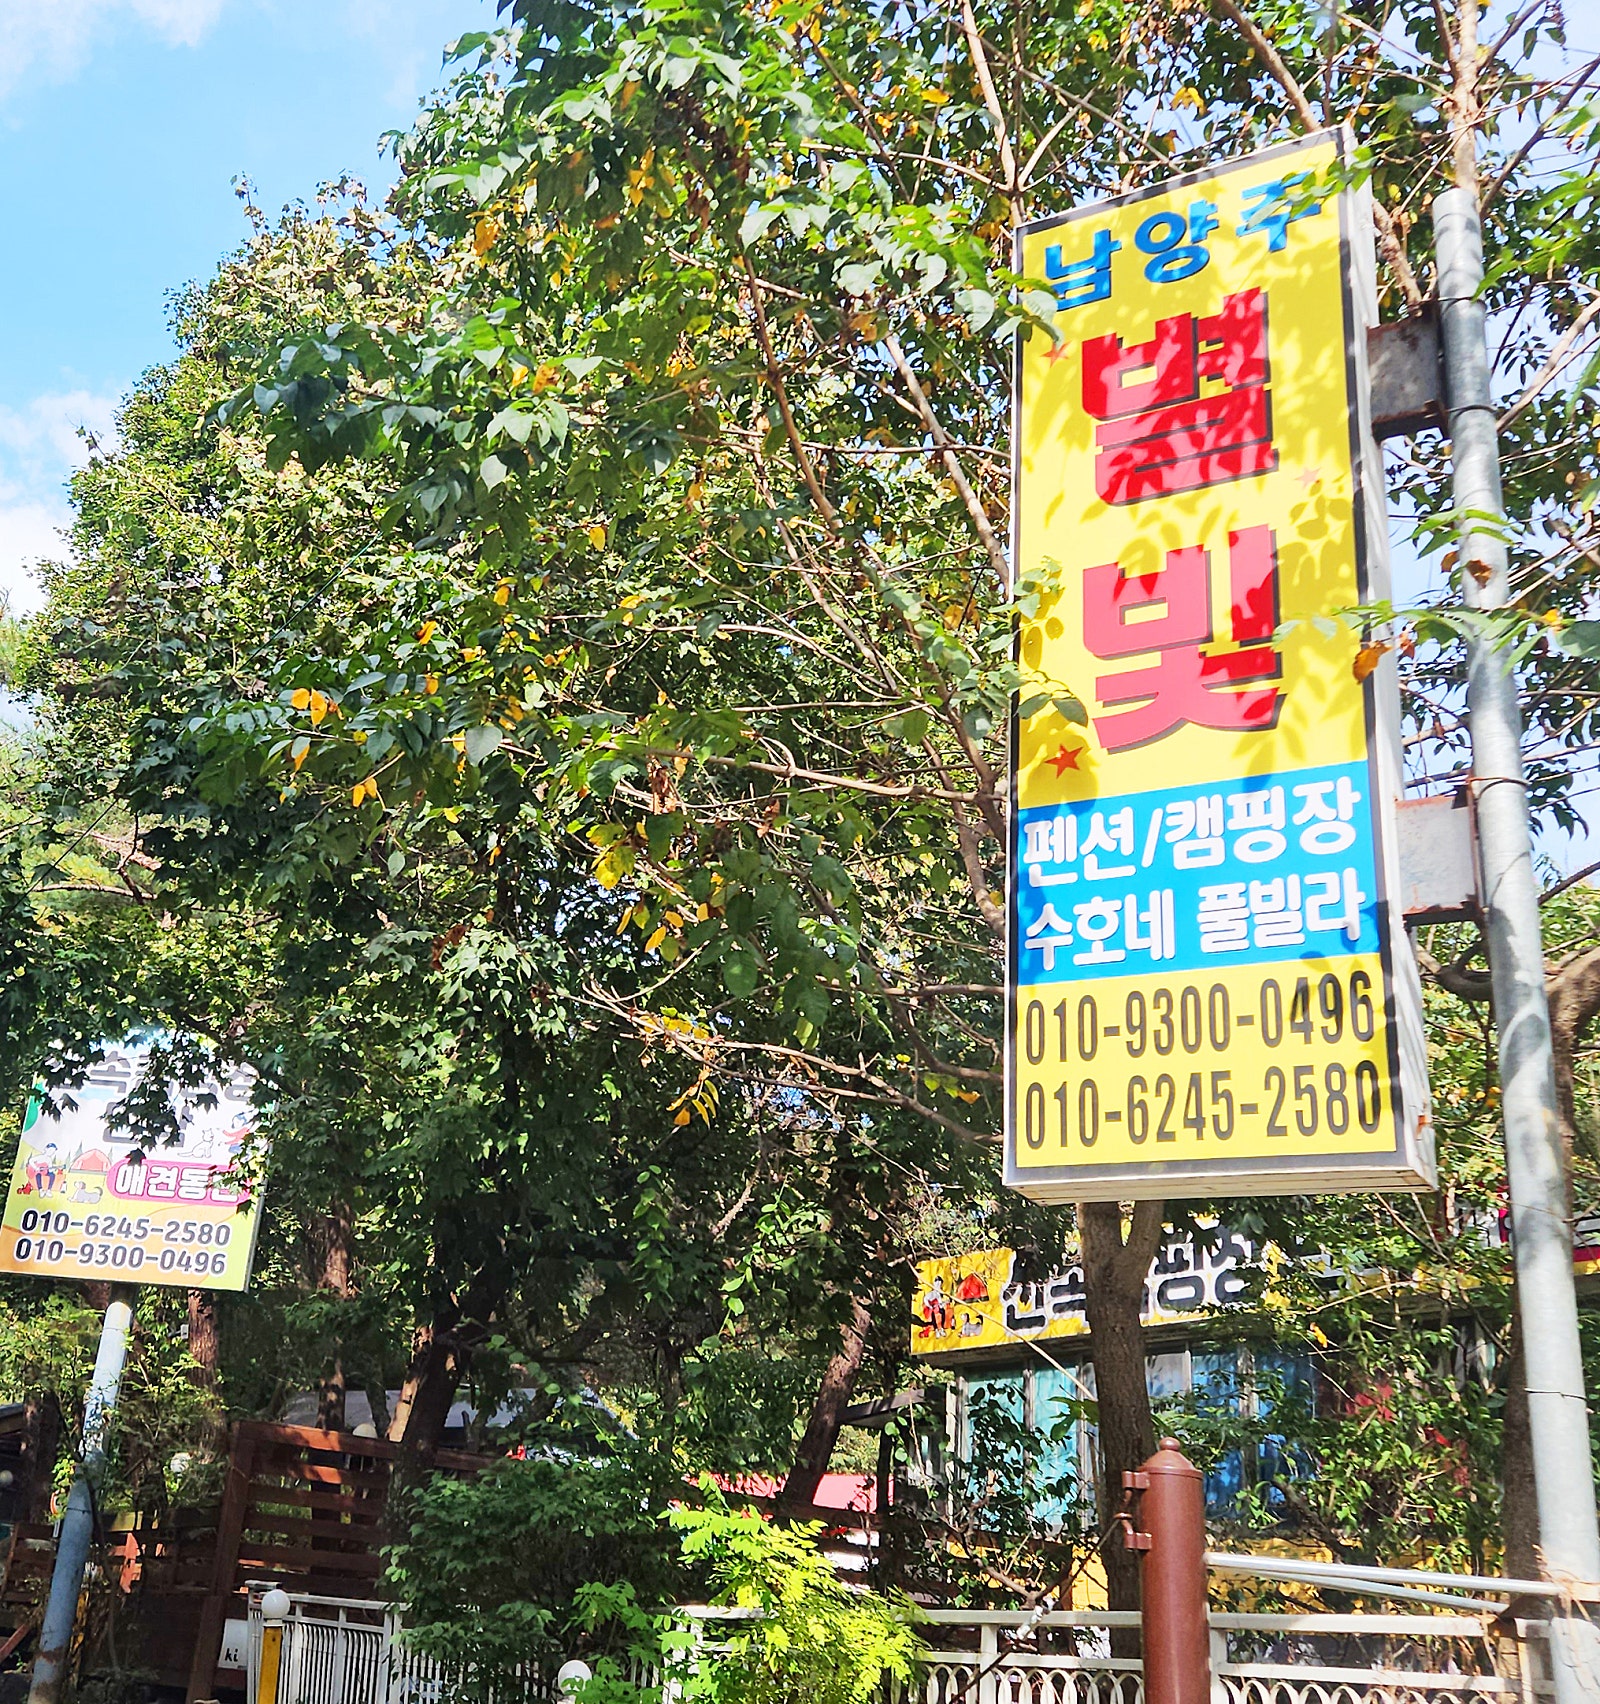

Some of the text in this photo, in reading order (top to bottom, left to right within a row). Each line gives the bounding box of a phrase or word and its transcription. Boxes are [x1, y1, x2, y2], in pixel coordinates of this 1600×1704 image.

[1044, 172, 1321, 311] 남양주
[1023, 776, 1360, 887] 펜션/캠핑장
[1025, 868, 1365, 971] 수호네 풀빌라
[1026, 970, 1376, 1065] 010-9300-0496
[1026, 1060, 1380, 1150] 010-6245-2580
[15, 1238, 227, 1275] 010-9300-0496
[21, 1210, 231, 1246] 010-6245-2580
